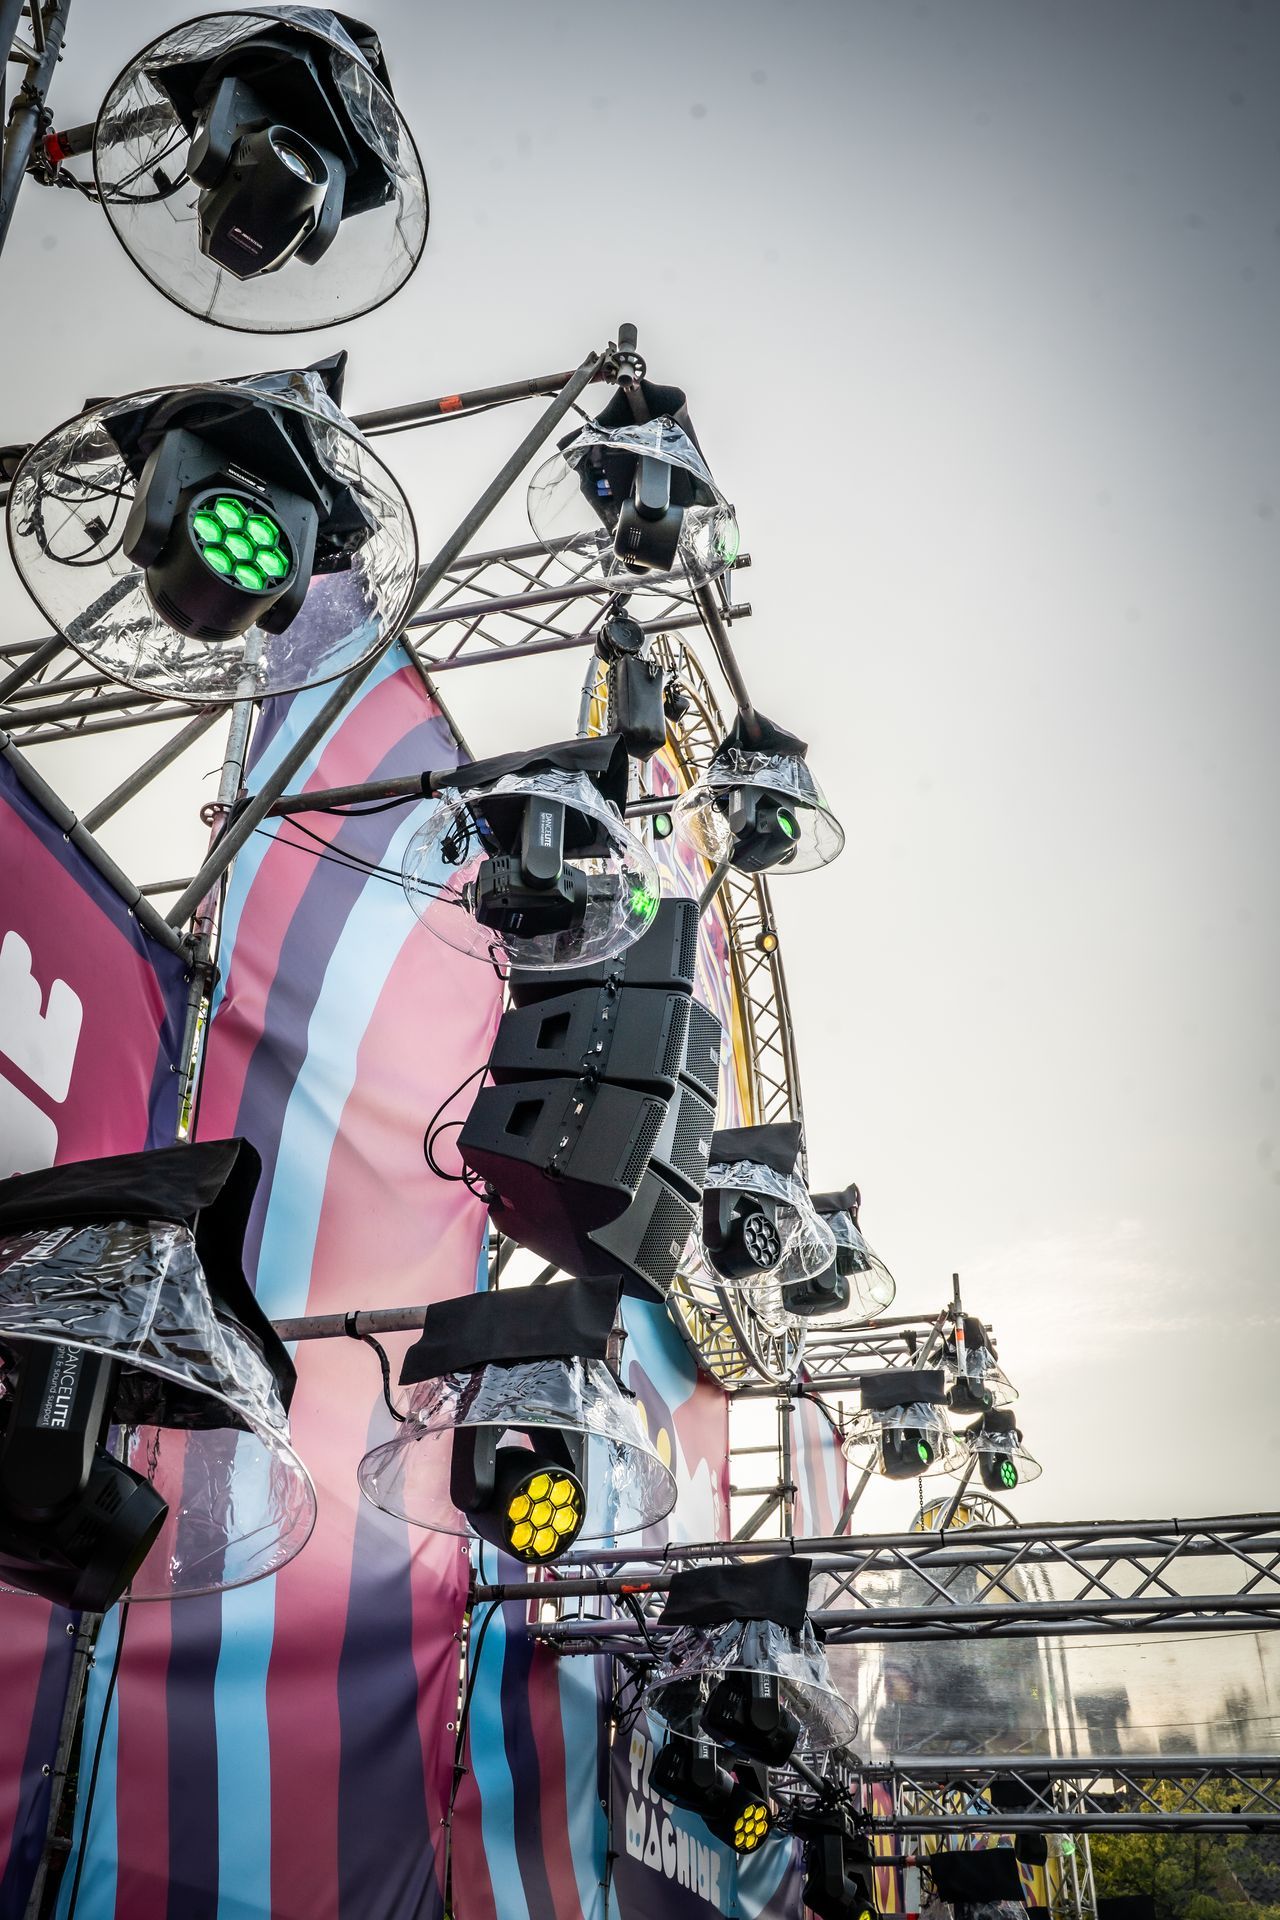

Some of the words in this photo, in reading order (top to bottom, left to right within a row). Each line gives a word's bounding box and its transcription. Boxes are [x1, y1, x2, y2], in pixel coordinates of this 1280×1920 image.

[49, 1369, 61, 1394] sound
[41, 1395, 55, 1426] support
[625, 1791, 721, 1911] MACHINE
